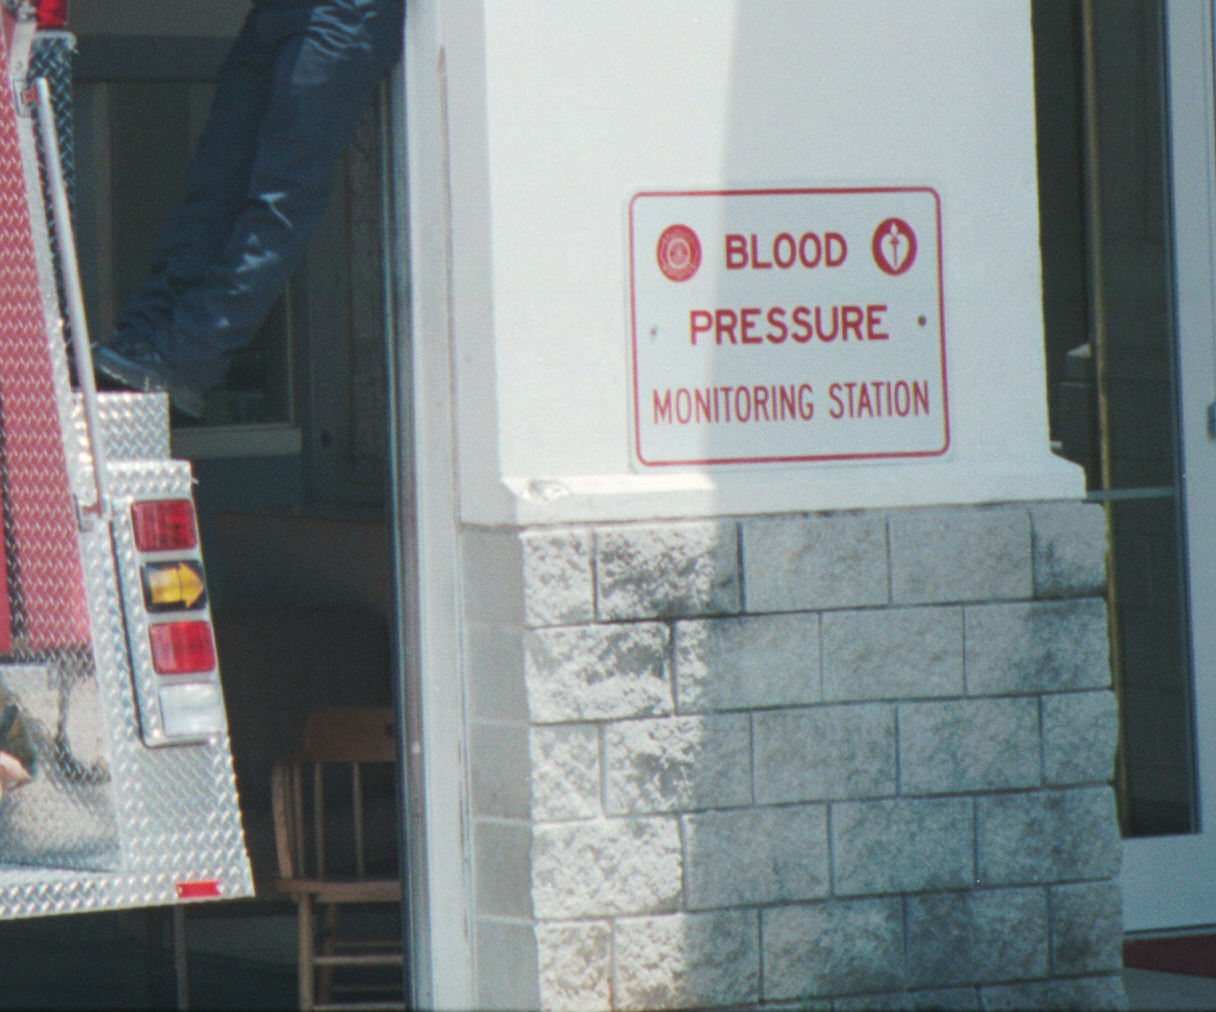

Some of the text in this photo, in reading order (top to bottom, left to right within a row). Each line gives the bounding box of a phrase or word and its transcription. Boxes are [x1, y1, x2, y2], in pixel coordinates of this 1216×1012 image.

[725, 231, 848, 270] BLOOD
[689, 304, 890, 346] PRESSURE
[652, 379, 931, 425] MONITORING STATION
